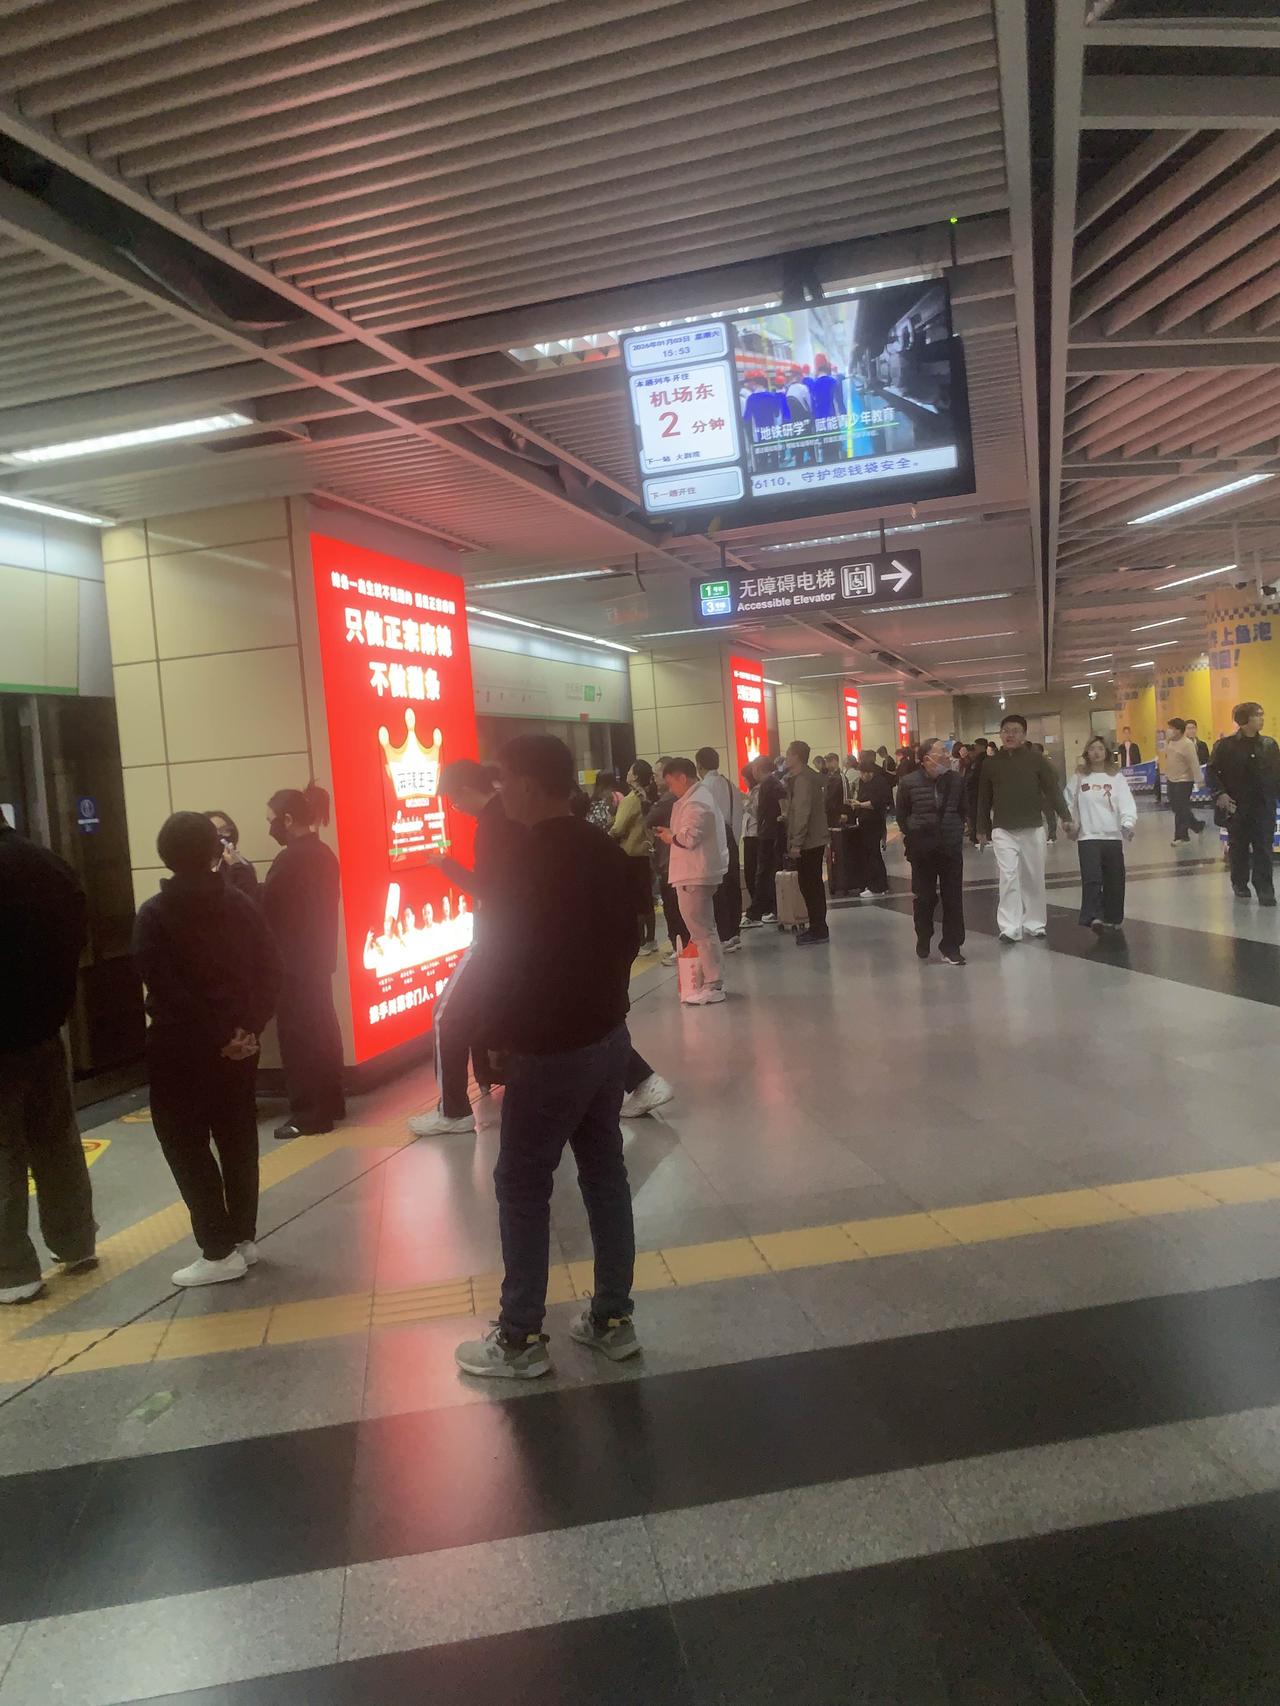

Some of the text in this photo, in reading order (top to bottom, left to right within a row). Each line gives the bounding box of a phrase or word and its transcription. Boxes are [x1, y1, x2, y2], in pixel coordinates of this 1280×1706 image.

[663, 346, 691, 358] 15:53
[649, 383, 715, 408] 机场东
[658, 411, 725, 438] 2 分钟
[738, 567, 837, 600] 无障碍电梯
[737, 592, 837, 613] Accessible Elevator
